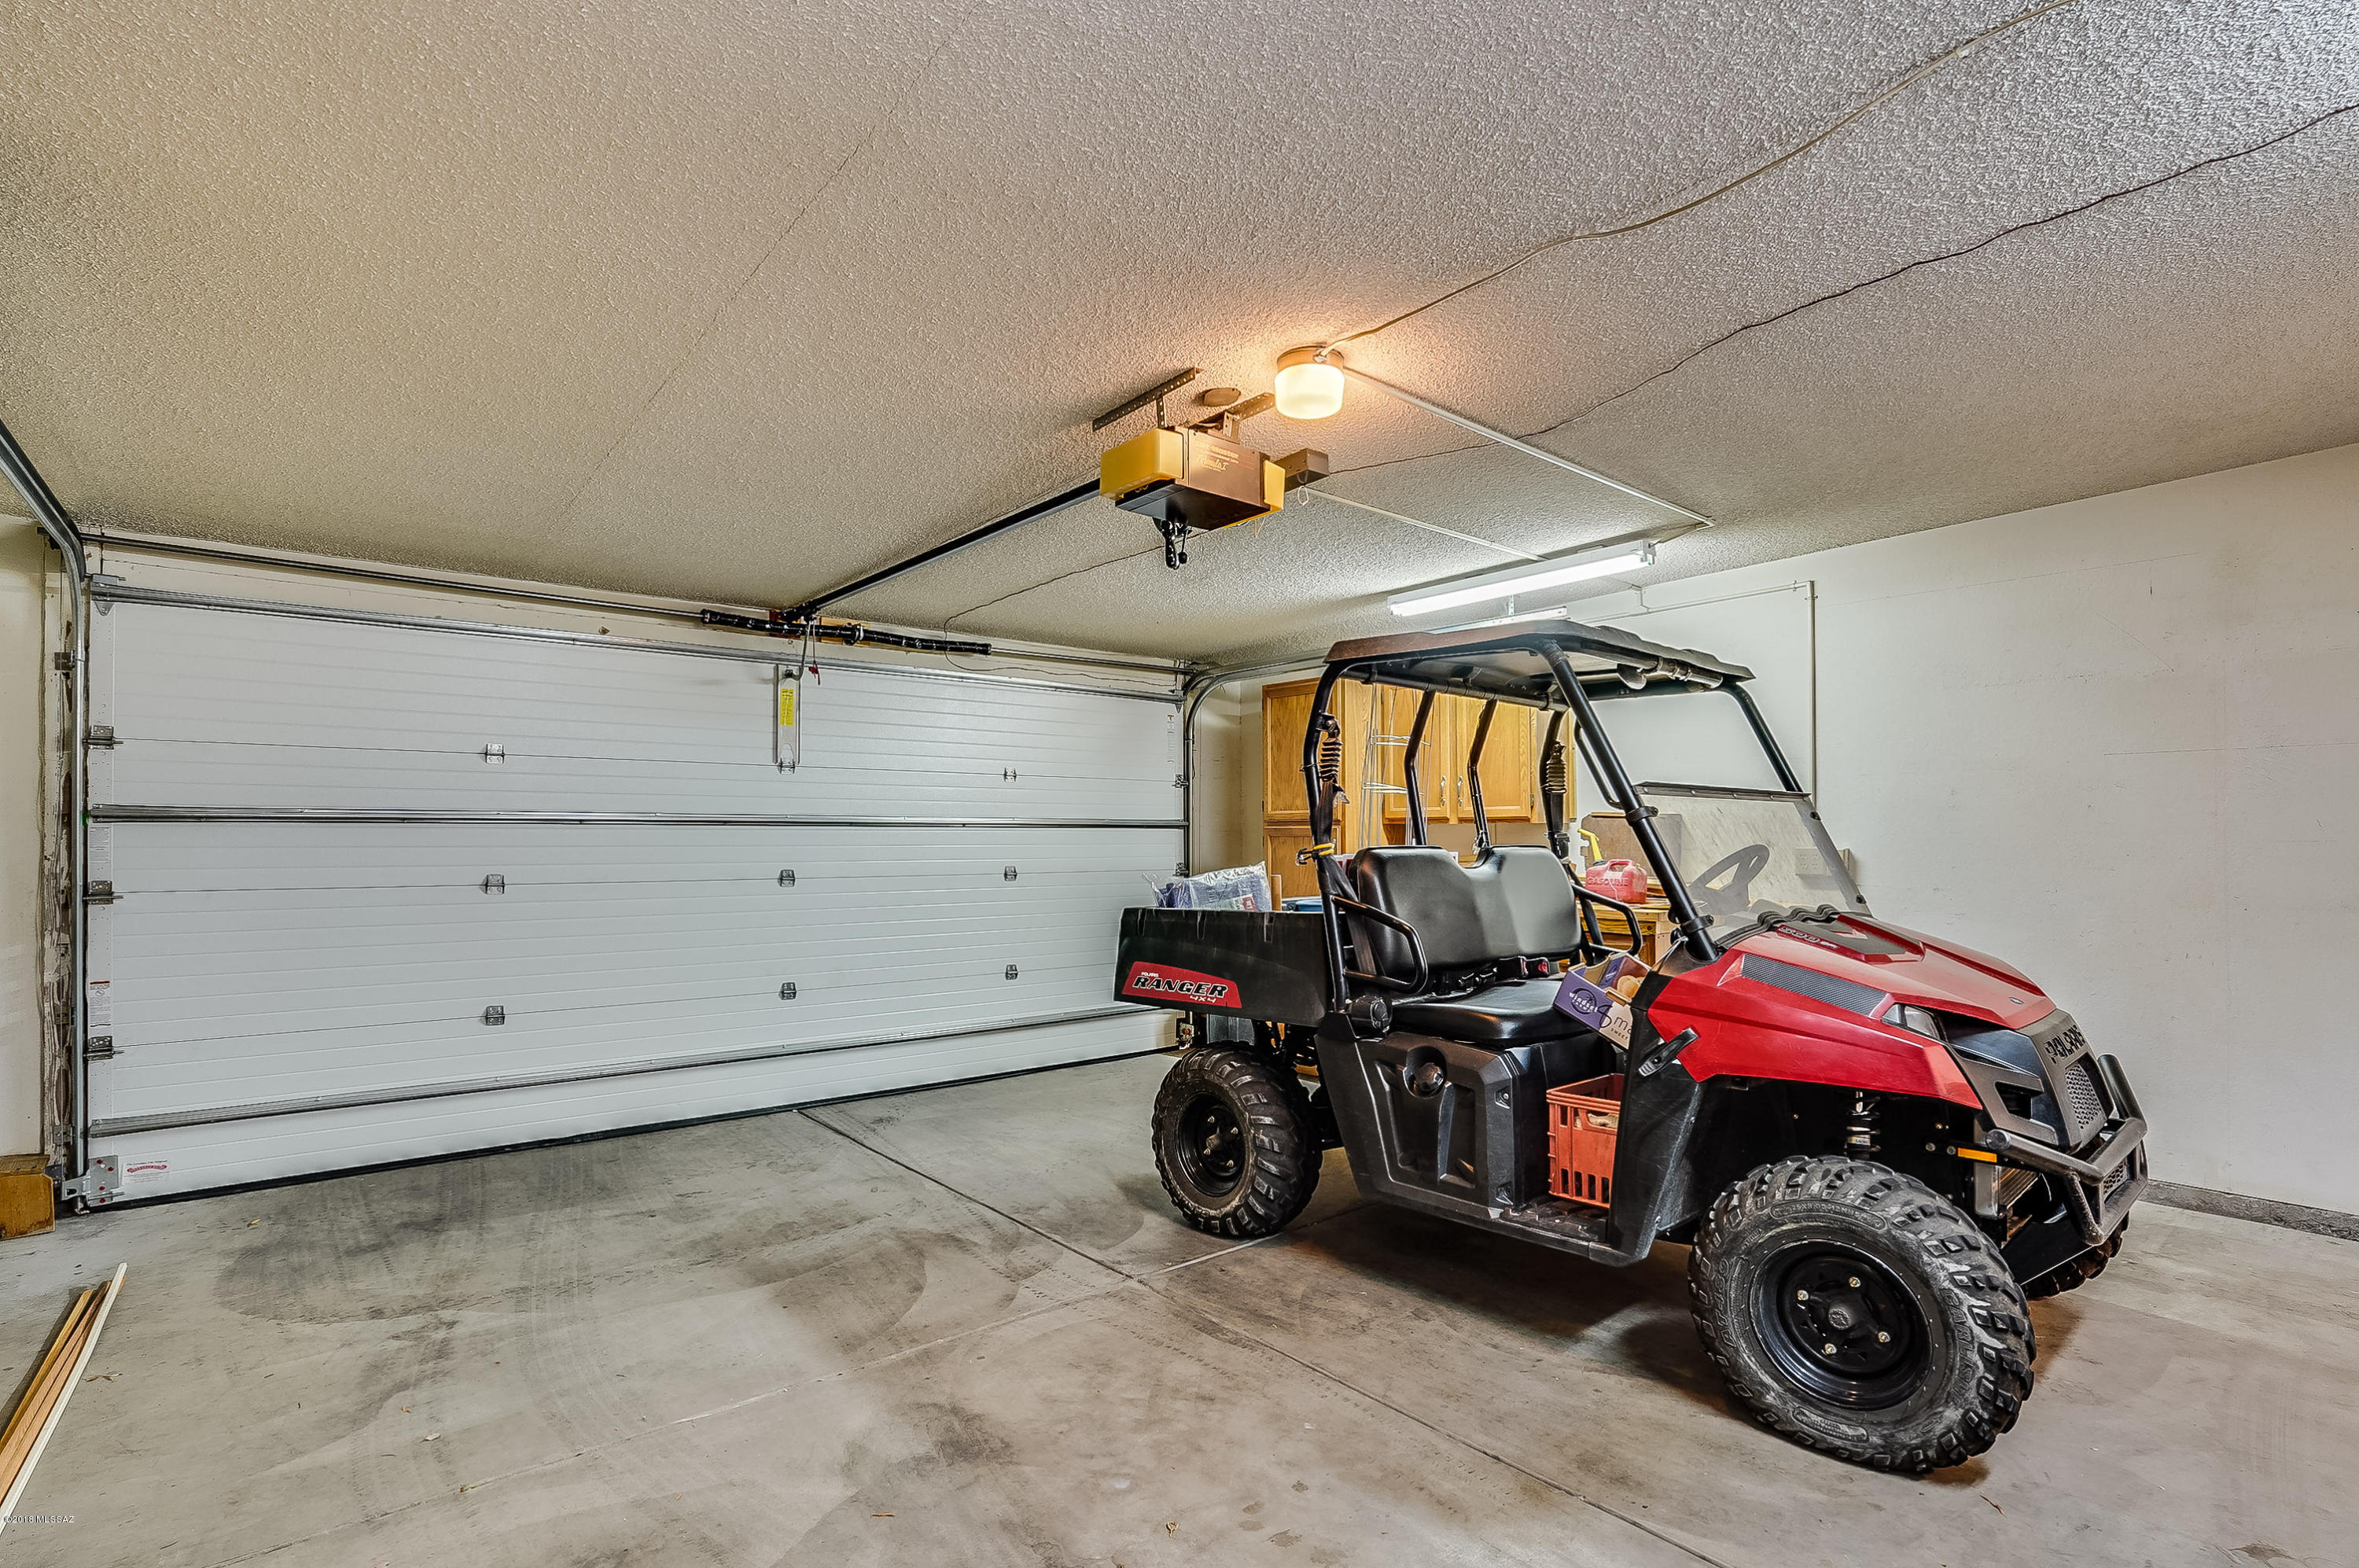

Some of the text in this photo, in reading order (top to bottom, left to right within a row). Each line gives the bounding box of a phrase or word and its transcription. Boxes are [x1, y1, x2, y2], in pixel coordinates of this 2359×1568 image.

[1132, 975, 1228, 999] RANGER
[1569, 992, 1598, 1013] windset
[2044, 1025, 2086, 1064] POLARIS
[1939, 1288, 1974, 1405] CARLISLE
